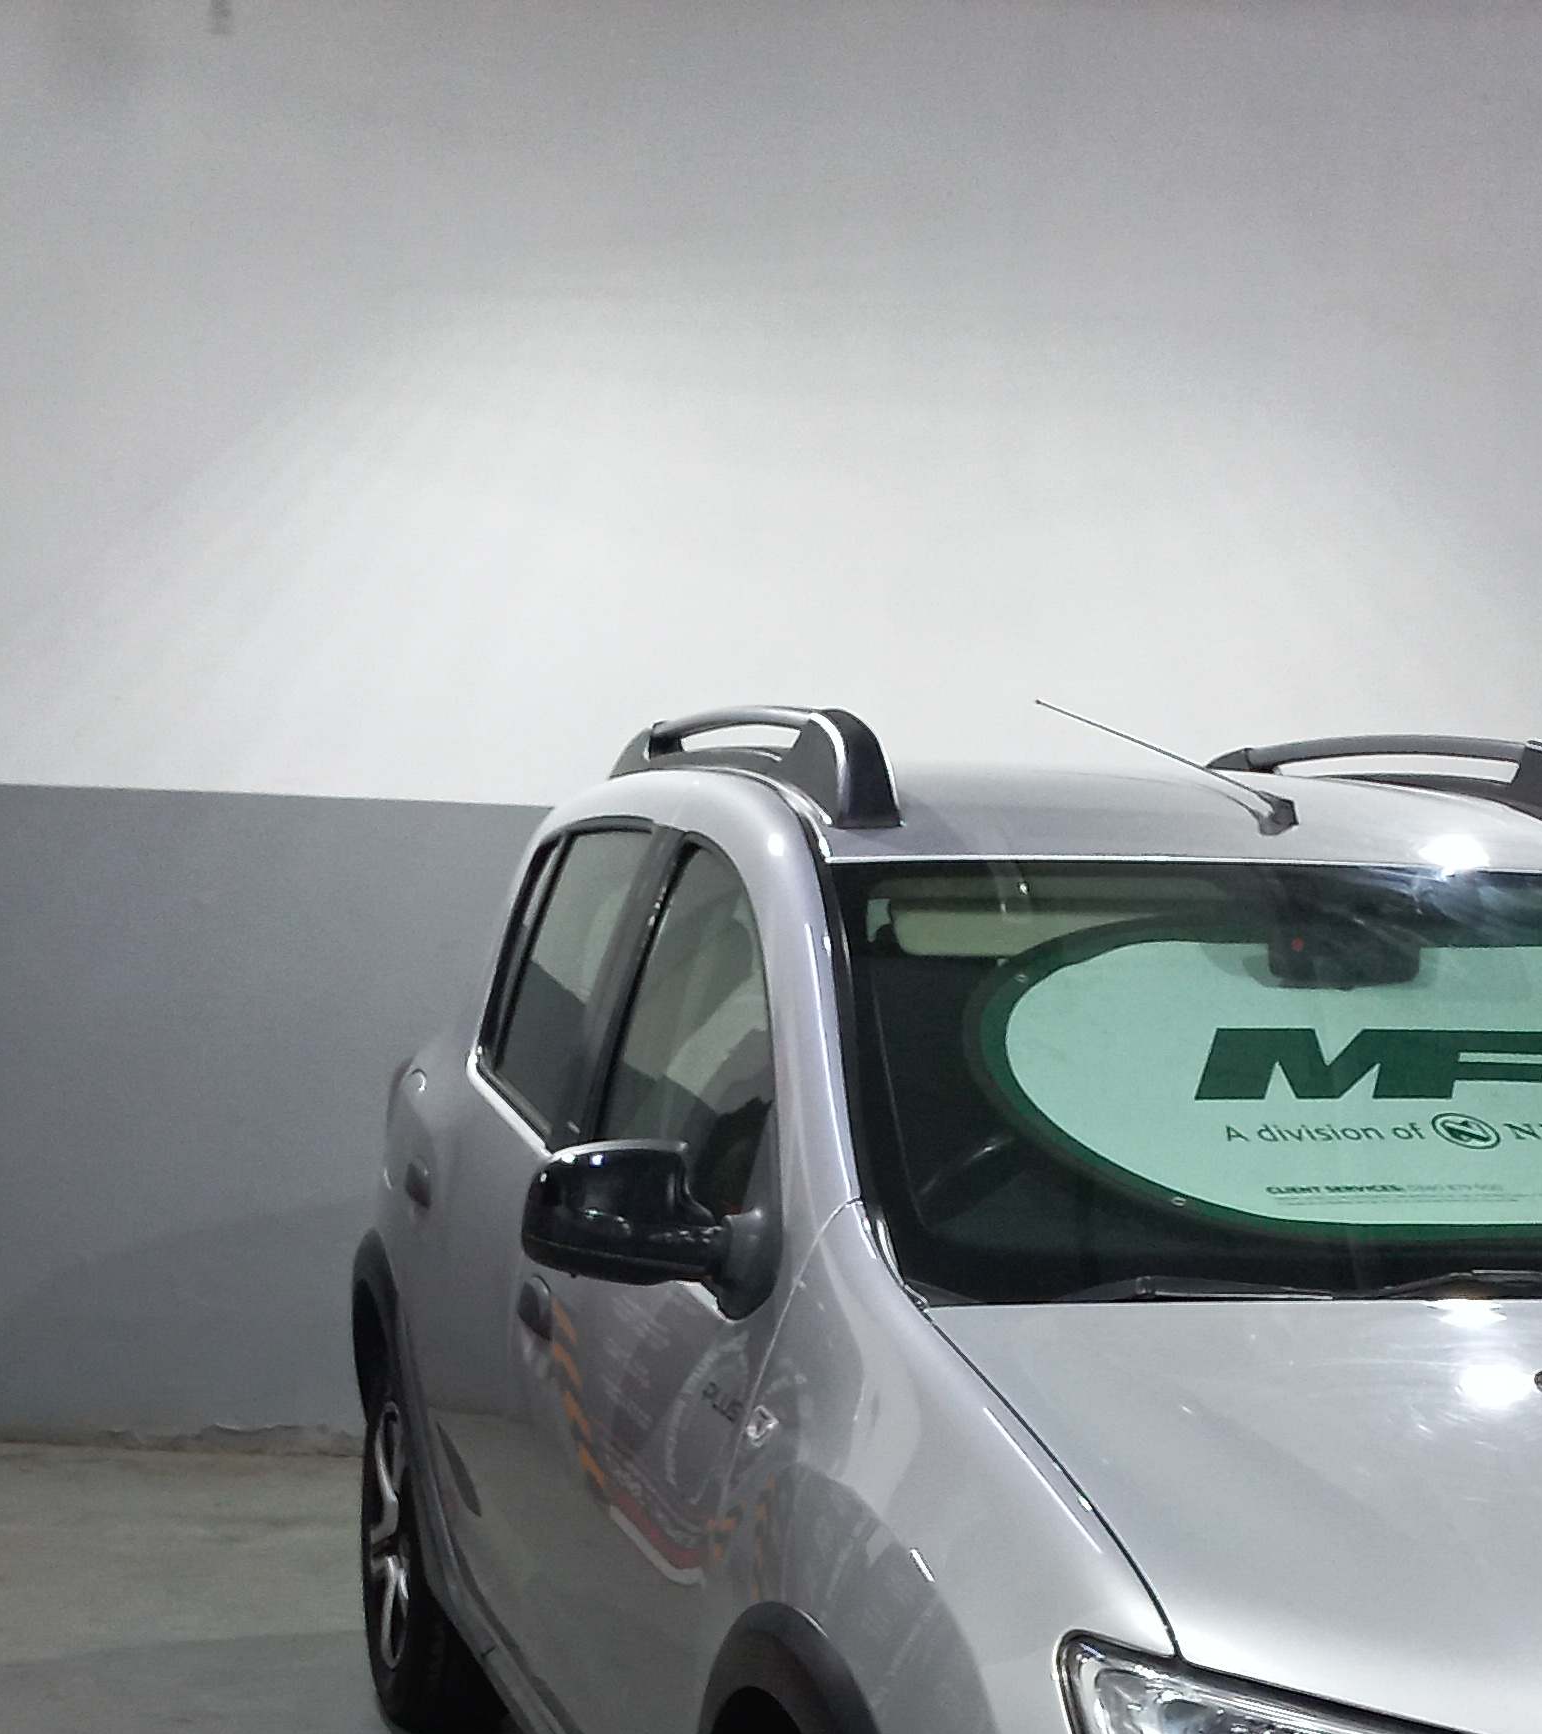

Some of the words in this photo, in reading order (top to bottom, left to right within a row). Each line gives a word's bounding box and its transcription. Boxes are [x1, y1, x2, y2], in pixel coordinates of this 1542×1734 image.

[1225, 1125, 1248, 1142] A
[1257, 1122, 1383, 1143] division
[1391, 1121, 1427, 1141] of
